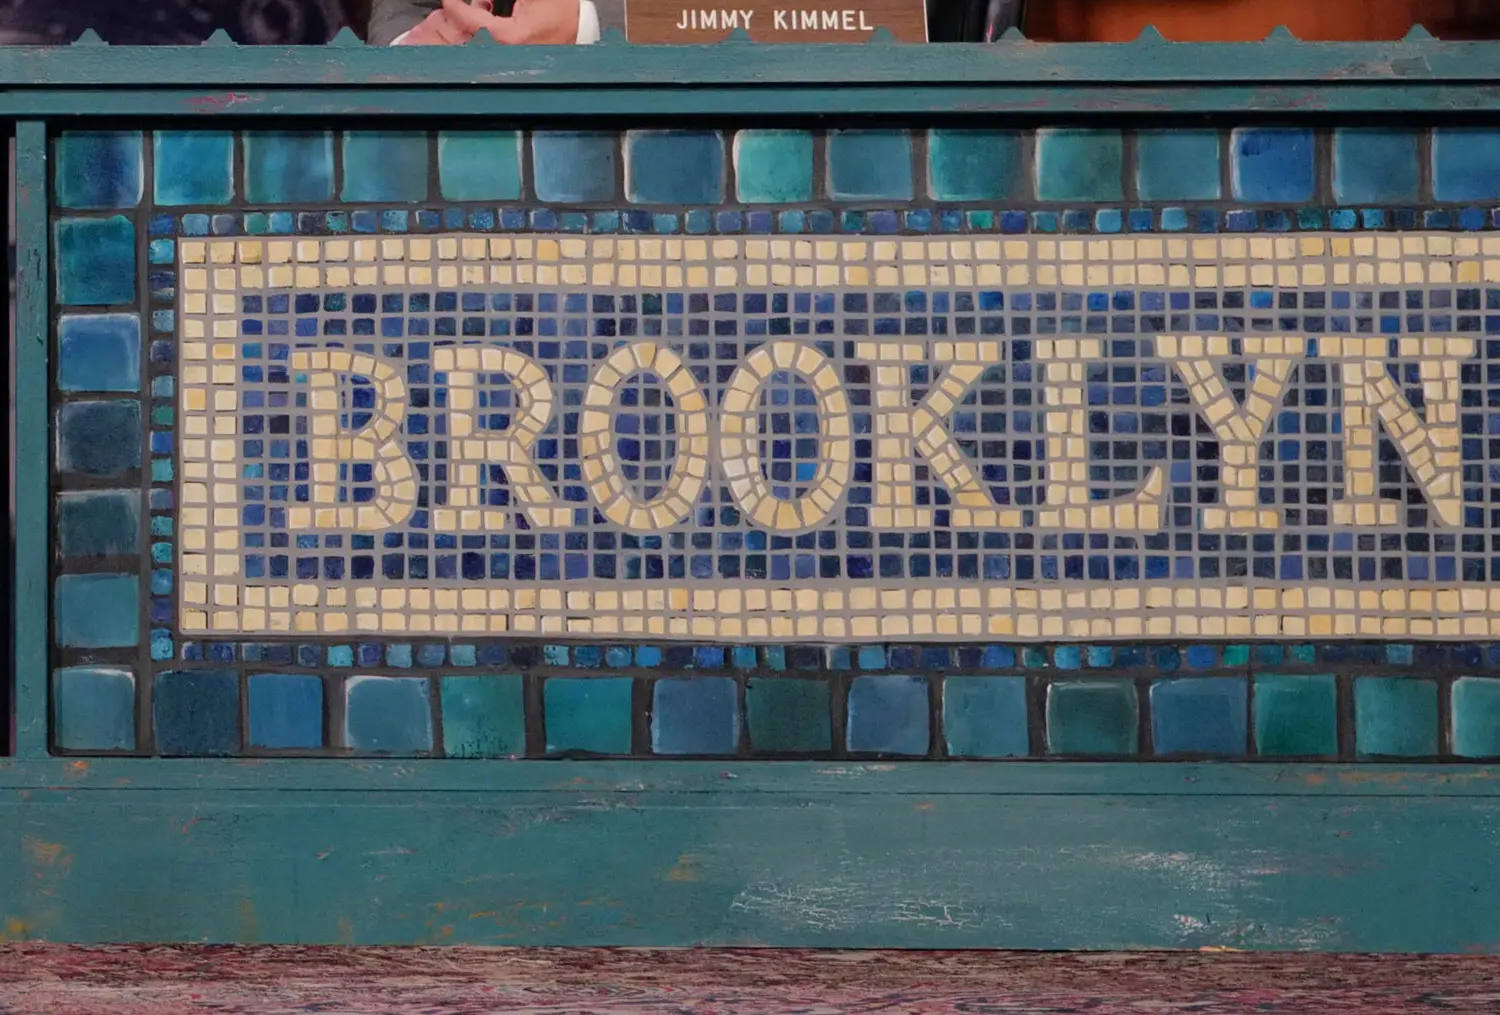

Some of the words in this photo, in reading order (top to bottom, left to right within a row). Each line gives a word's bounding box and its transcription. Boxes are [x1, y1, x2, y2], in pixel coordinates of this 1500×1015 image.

[676, 9, 756, 32] JIMMY
[774, 8, 874, 32] KIMMEL
[287, 336, 1476, 534] BROOKLYN
